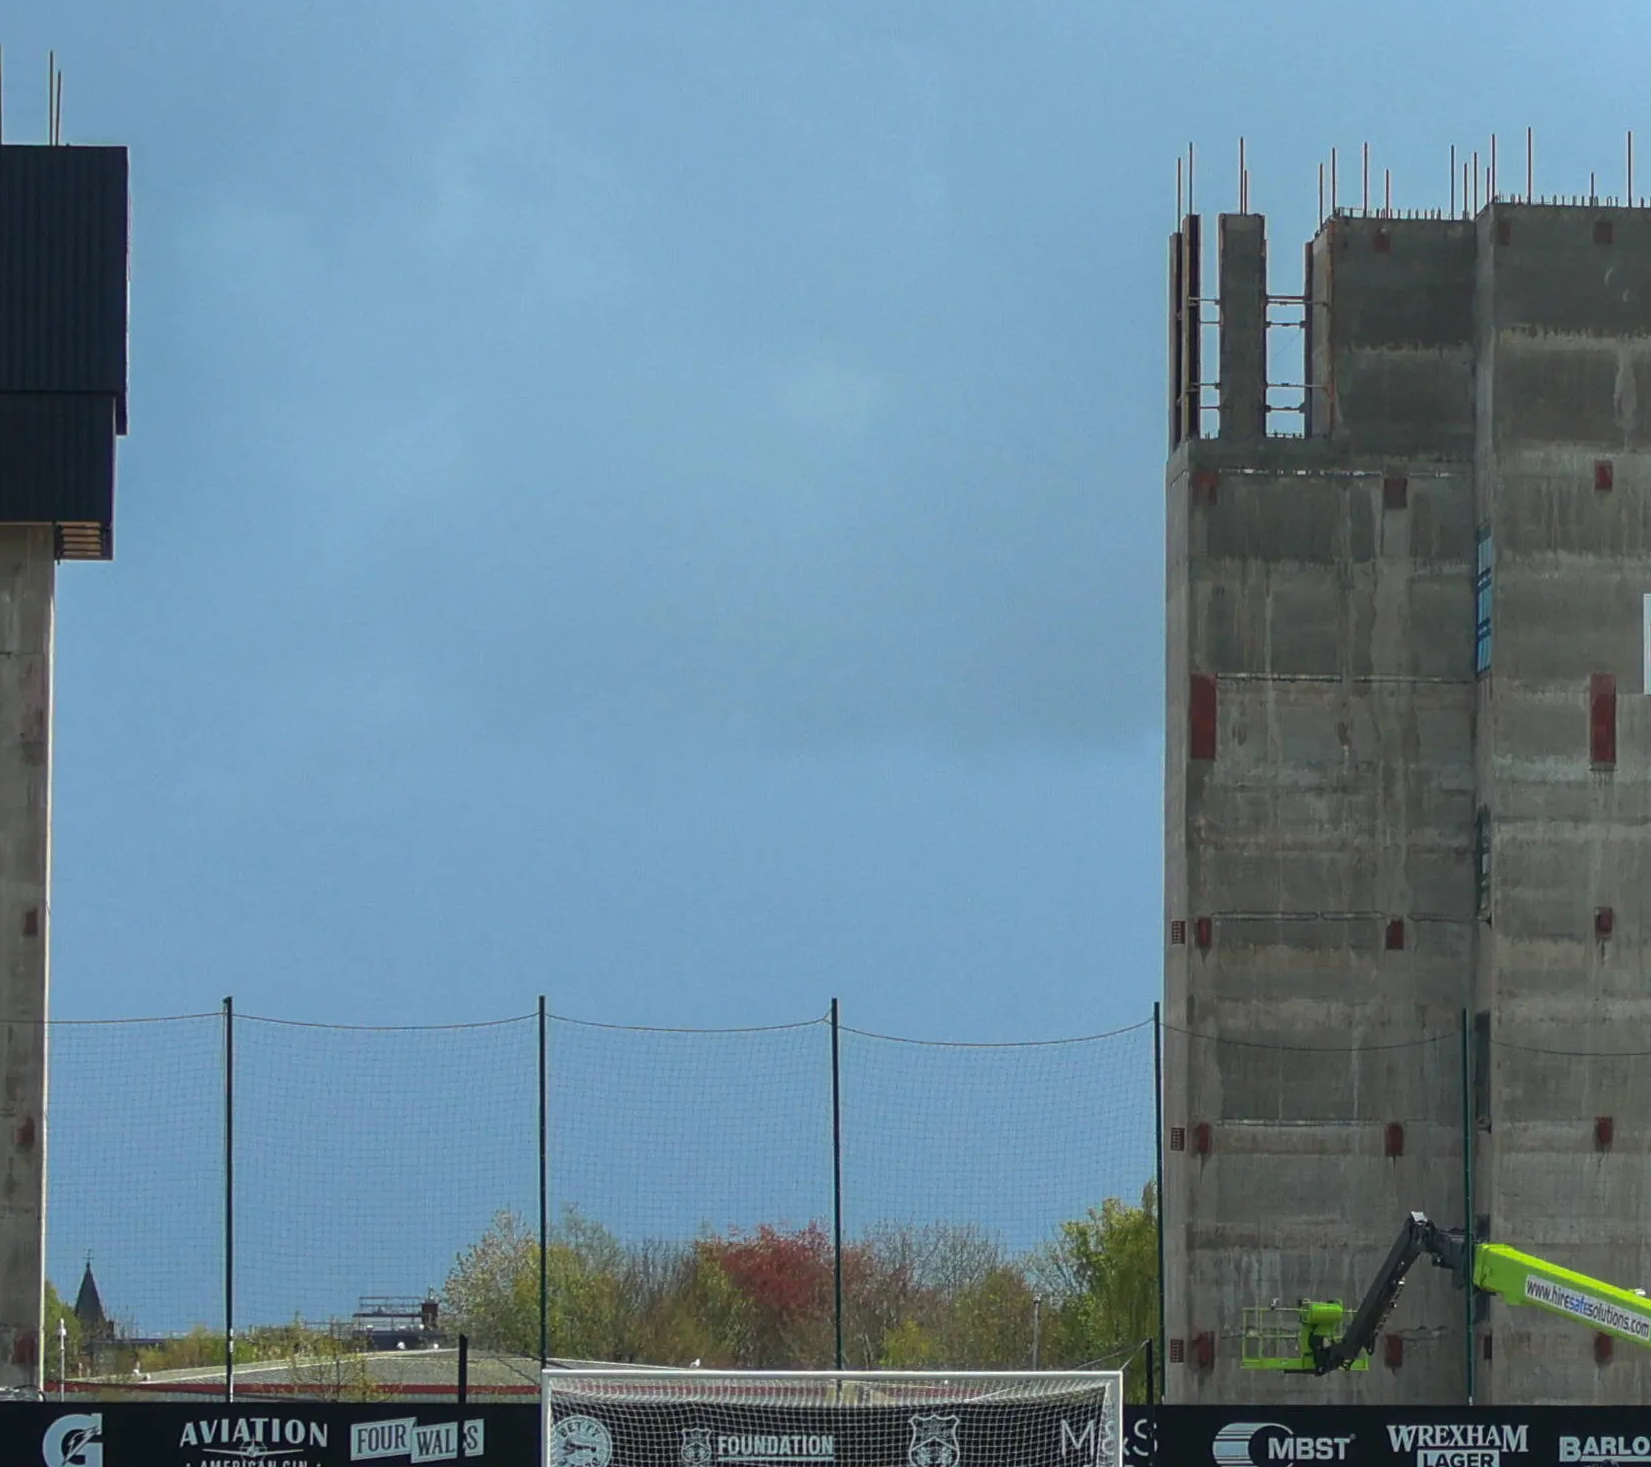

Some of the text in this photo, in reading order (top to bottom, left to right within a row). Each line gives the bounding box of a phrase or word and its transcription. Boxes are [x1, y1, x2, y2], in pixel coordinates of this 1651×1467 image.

[1526, 1278, 1650, 1337] www.hiresafesolutions.com
[179, 1417, 329, 1448] AVIATION
[356, 1423, 479, 1458] FOUR WALS
[717, 1435, 834, 1455] FOUNDATION
[1386, 1424, 1530, 1453] WREXHAM
[1268, 1437, 1351, 1460] MBST
